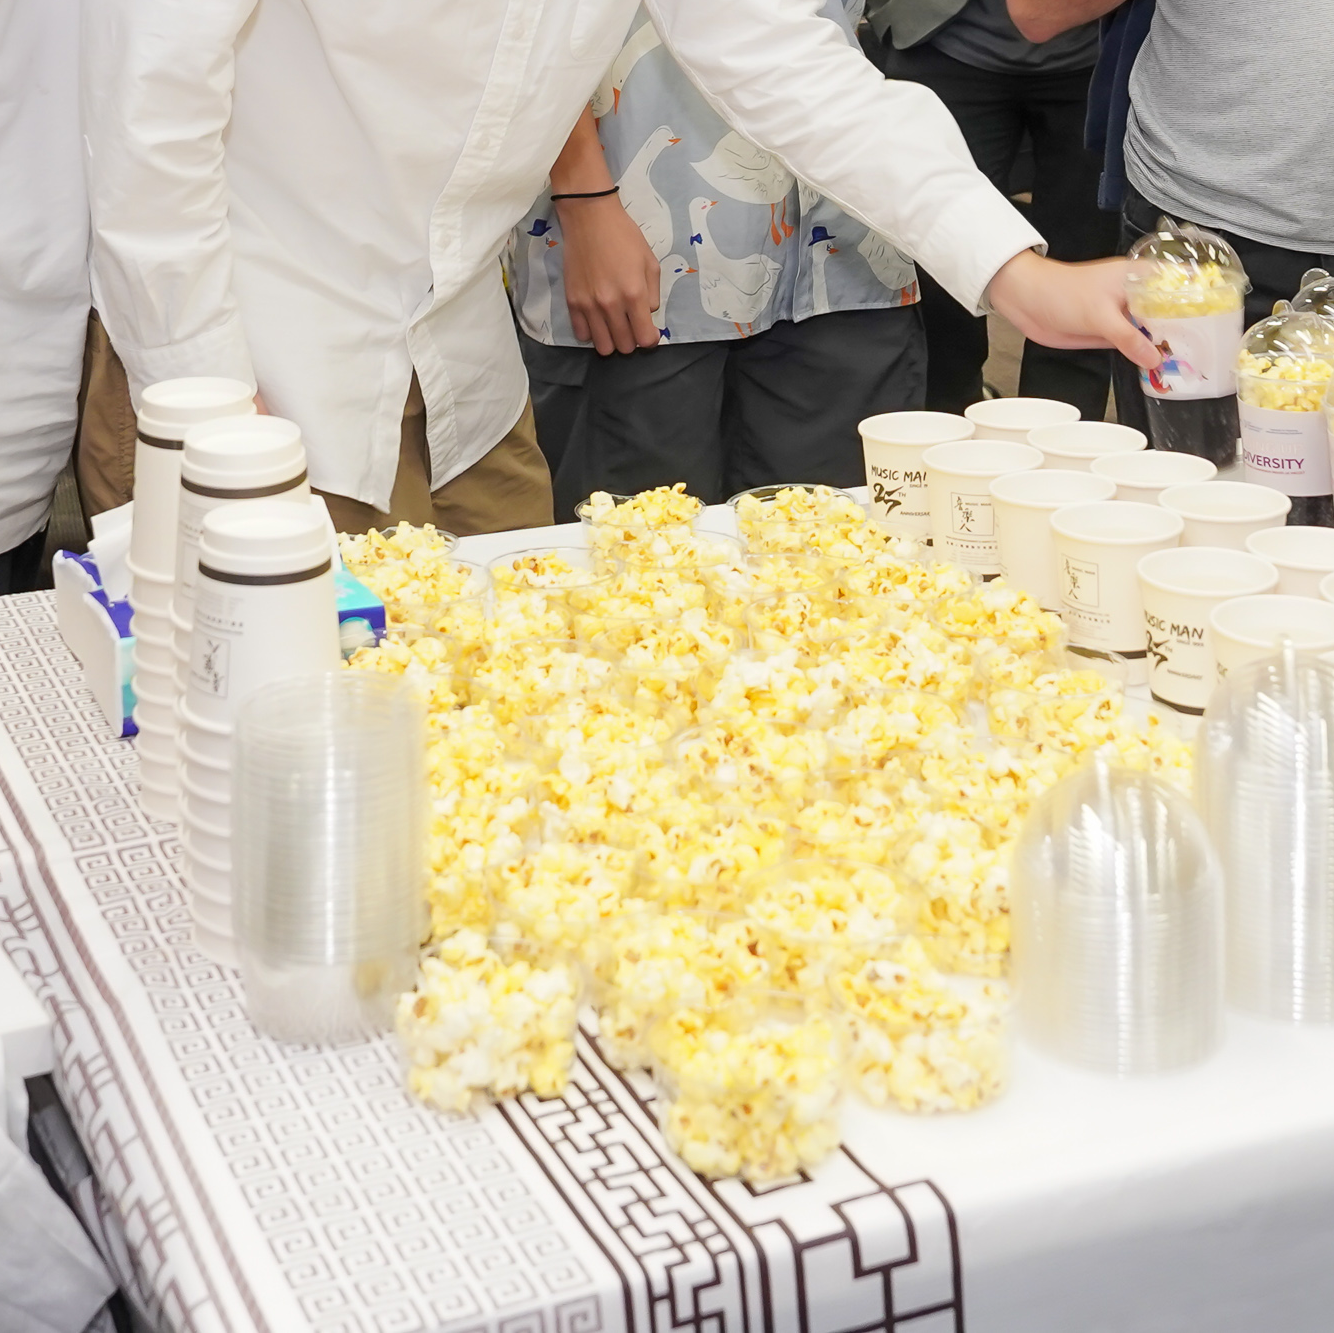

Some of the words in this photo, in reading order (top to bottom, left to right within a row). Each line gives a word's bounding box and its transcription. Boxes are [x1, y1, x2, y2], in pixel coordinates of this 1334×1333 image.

[871, 465, 900, 481] MUSIC
[900, 510, 931, 518] ANNIVERSAR
[1170, 622, 1204, 640] MAN
